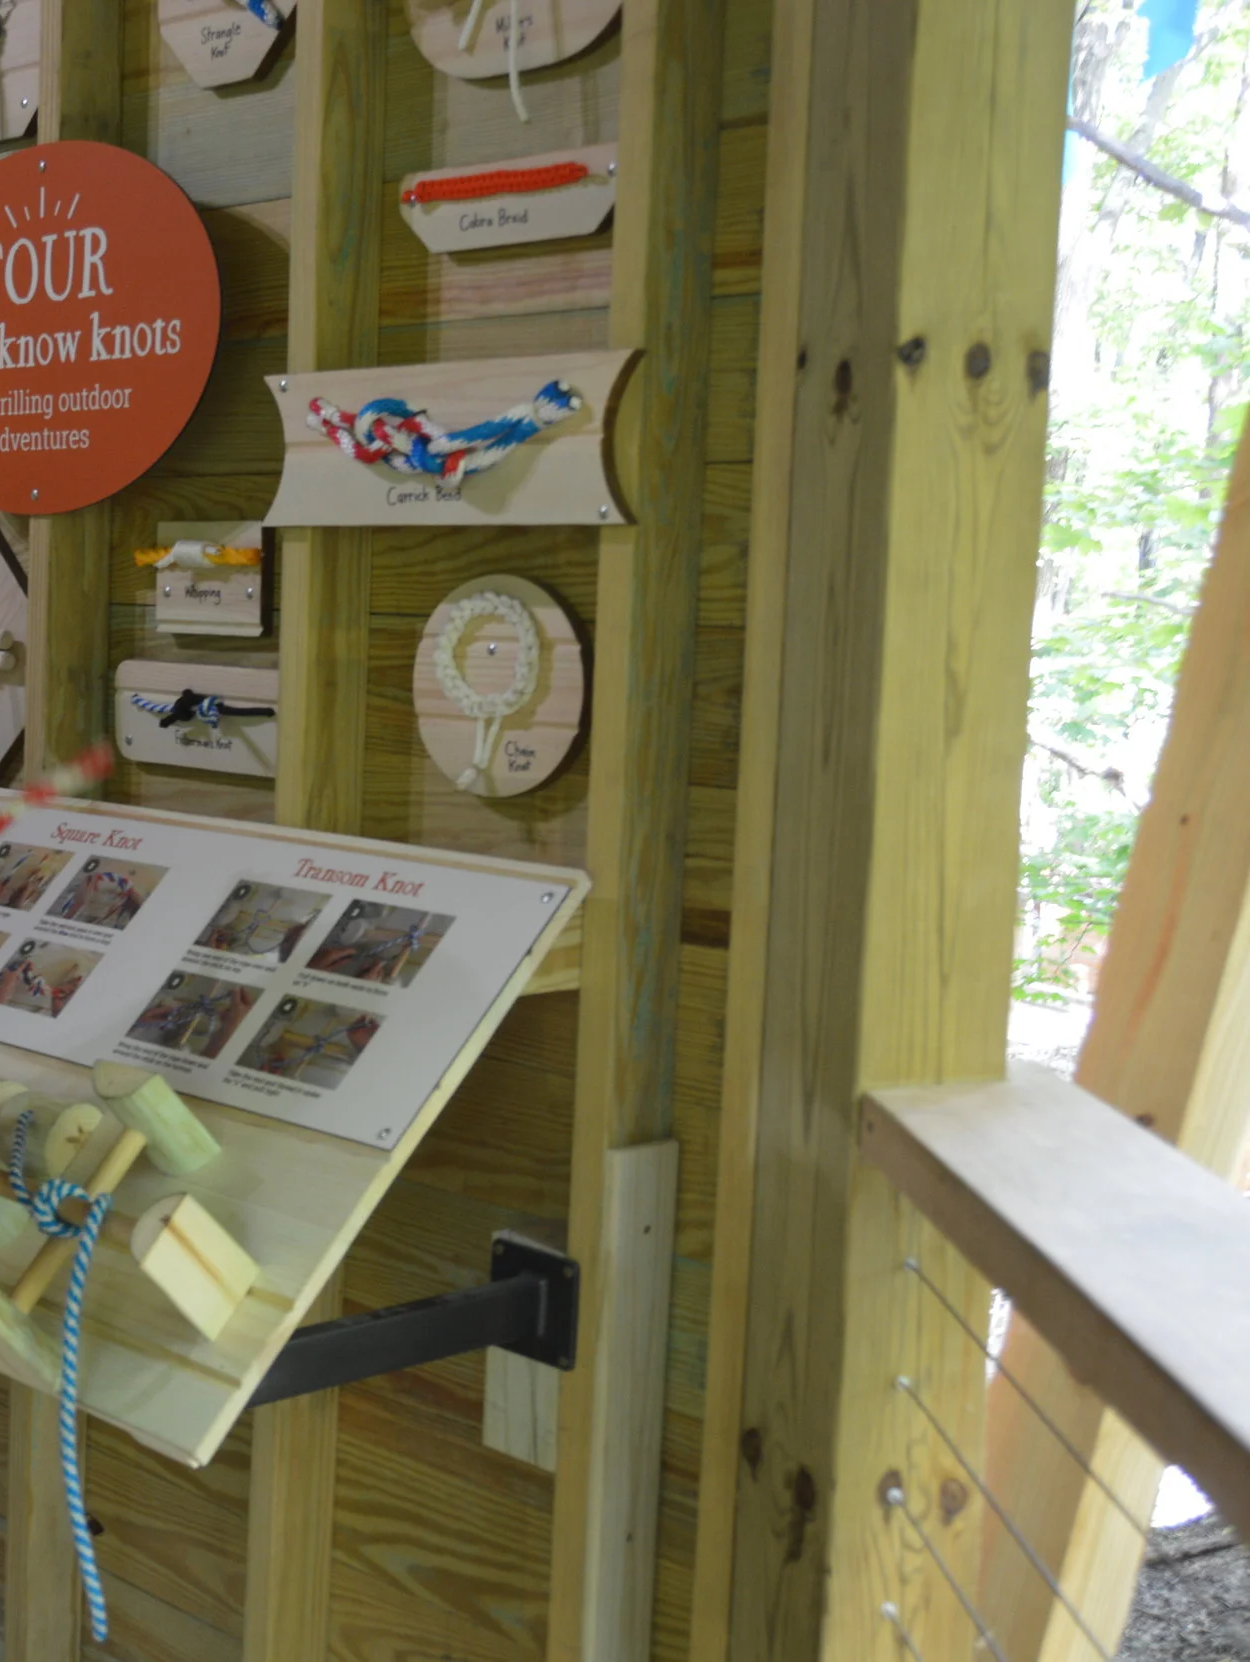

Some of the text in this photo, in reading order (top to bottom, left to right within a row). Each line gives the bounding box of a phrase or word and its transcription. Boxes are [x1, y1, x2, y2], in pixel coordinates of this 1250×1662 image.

[200, 21, 241, 45] Strangle
[503, 33, 526, 52] Kt
[458, 207, 528, 232] Cobra Braid
[89, 311, 182, 362] knots
[58, 383, 132, 412] outdoor
[386, 485, 430, 506] Carrick
[50, 822, 144, 851] Square Knot
[293, 858, 425, 897] Transom Knot
